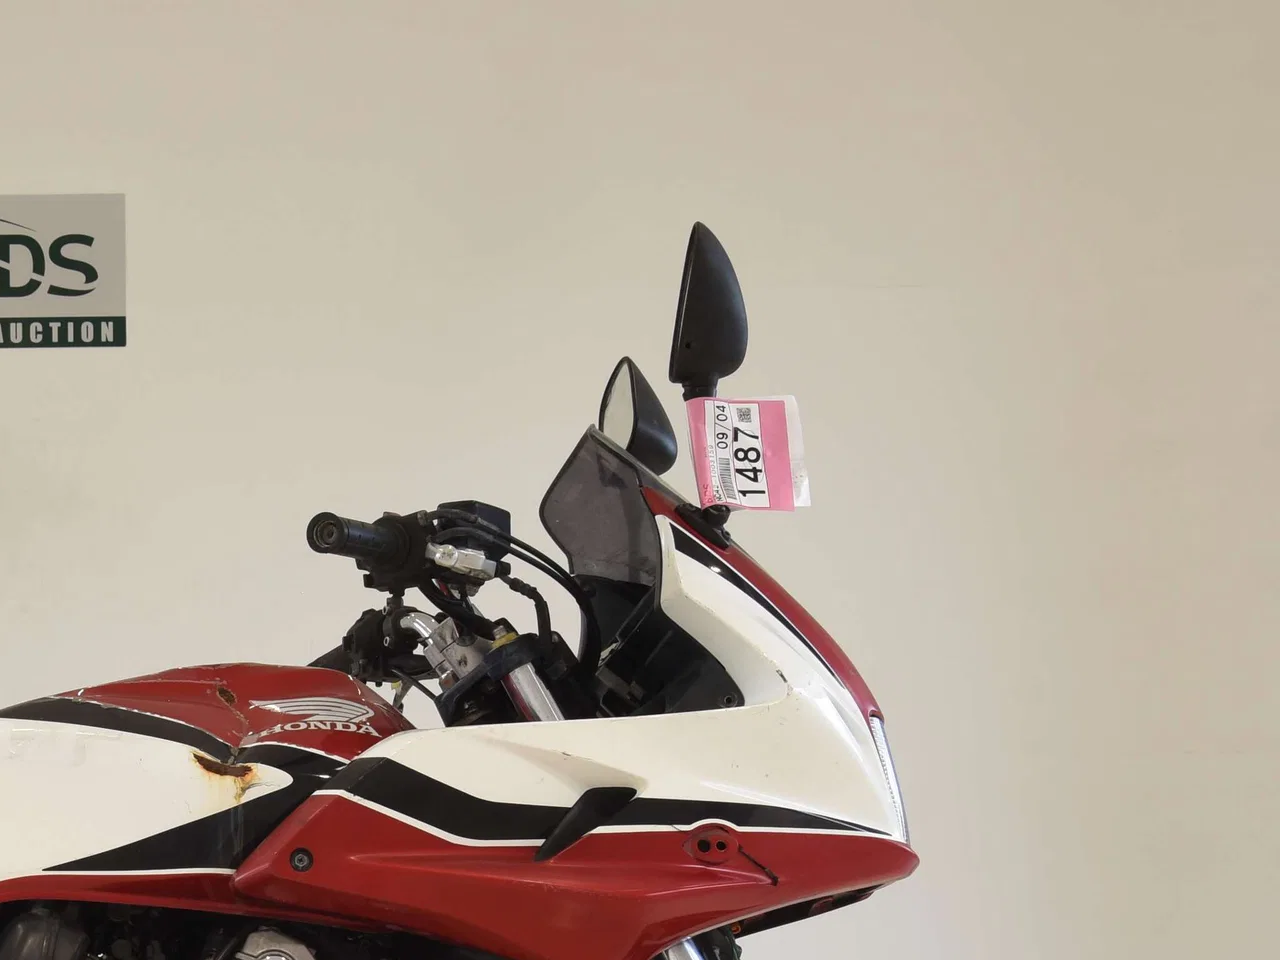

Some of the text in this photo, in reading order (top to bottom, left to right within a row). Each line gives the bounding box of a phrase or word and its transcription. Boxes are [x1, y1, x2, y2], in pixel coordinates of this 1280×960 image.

[715, 404, 731, 450] 09/04
[733, 426, 766, 498] 1487
[258, 721, 382, 738] HONDA
